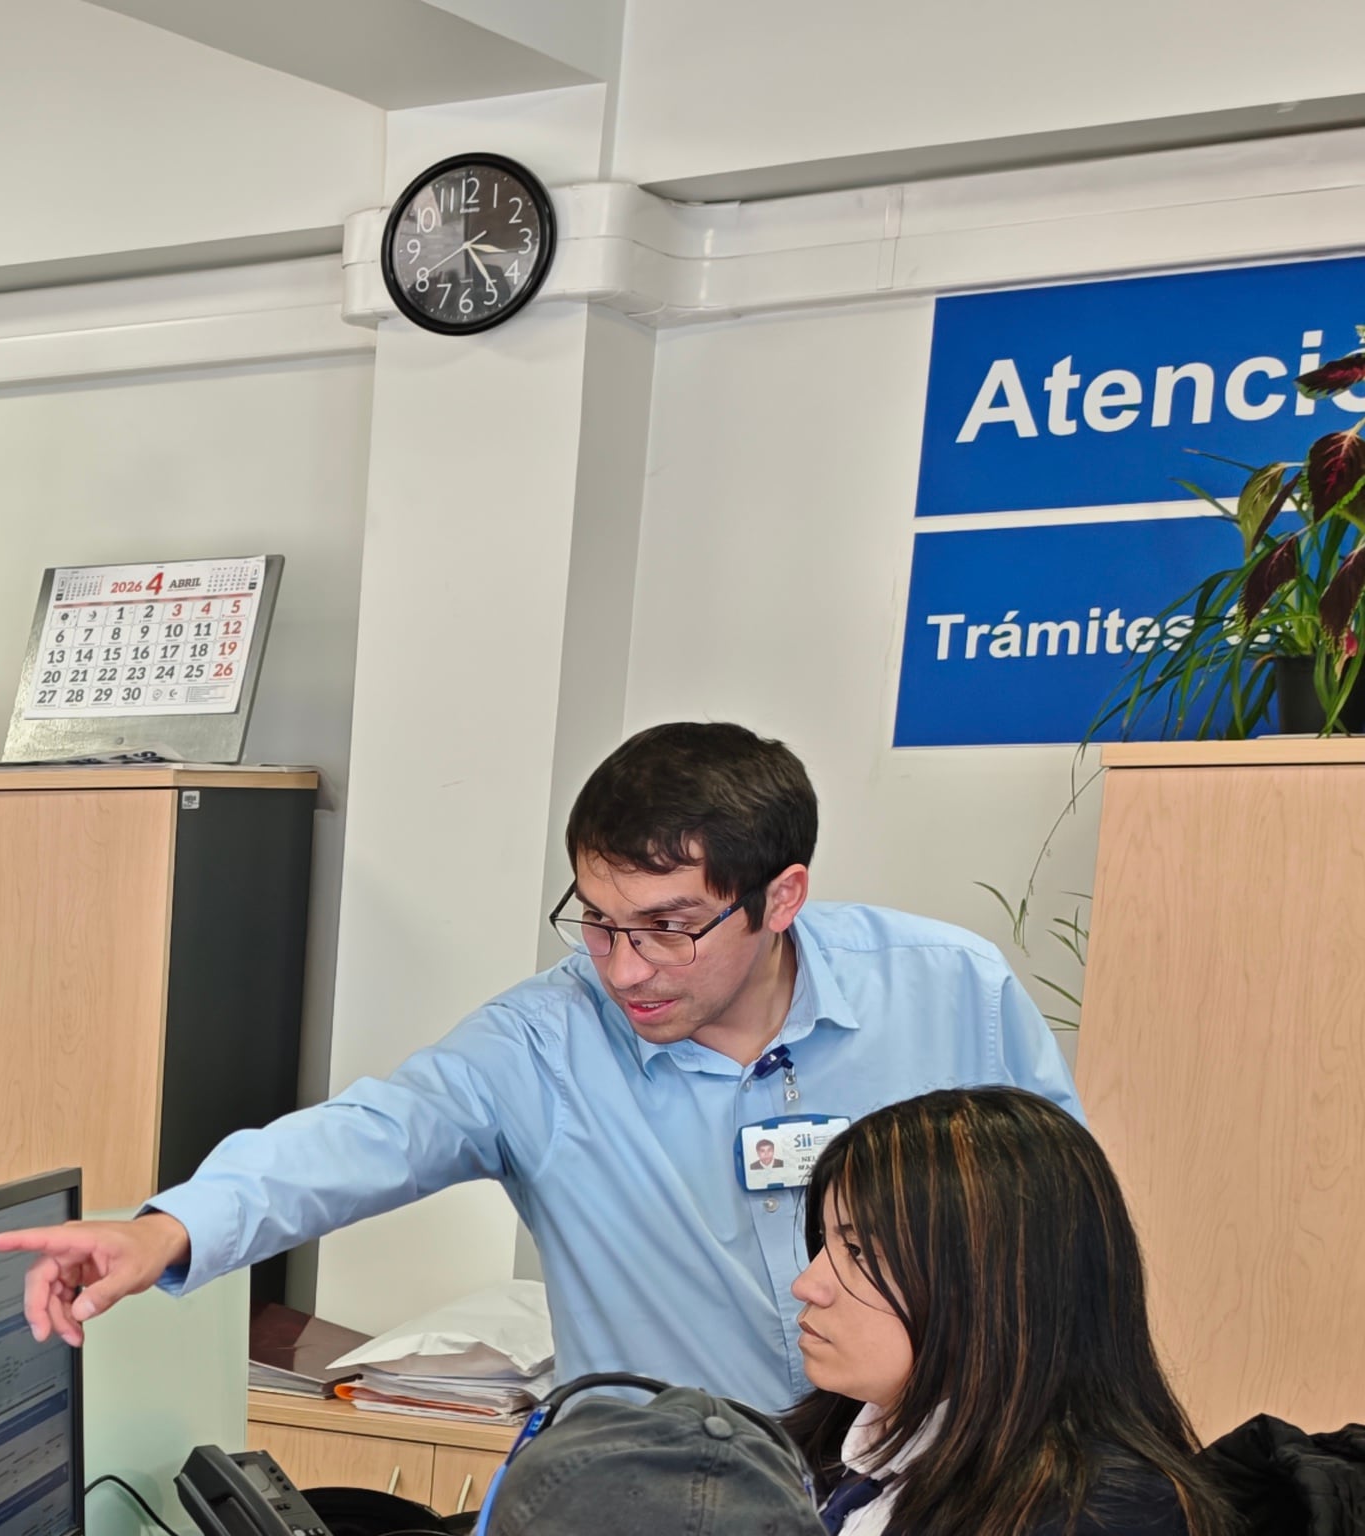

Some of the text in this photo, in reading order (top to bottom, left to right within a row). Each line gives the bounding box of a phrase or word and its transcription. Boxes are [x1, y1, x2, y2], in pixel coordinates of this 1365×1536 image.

[440, 187, 454, 213] 11
[461, 177, 480, 204] 12
[493, 183, 498, 208] 1
[416, 207, 436, 233] 10
[508, 197, 522, 224] 2
[407, 238, 421, 264] 9
[518, 228, 532, 255] 3
[415, 267, 429, 292] 8
[504, 259, 520, 285] 4
[436, 283, 453, 309] 7
[459, 288, 474, 313] 6
[483, 279, 498, 305] 5
[110, 581, 142, 594] 2026
[145, 572, 165, 595] 4
[169, 576, 201, 589] ABRIL
[116, 600, 241, 621] 1 2 3 4 5
[55, 621, 242, 643] 6 7 8 9 10 11 12
[926, 607, 1196, 662] Trámites
[47, 642, 237, 663] 13 14 15 16 17 18 19
[42, 662, 233, 684] 20 21 22 23 24 25 26
[37, 688, 141, 704] 27 28 29 30
